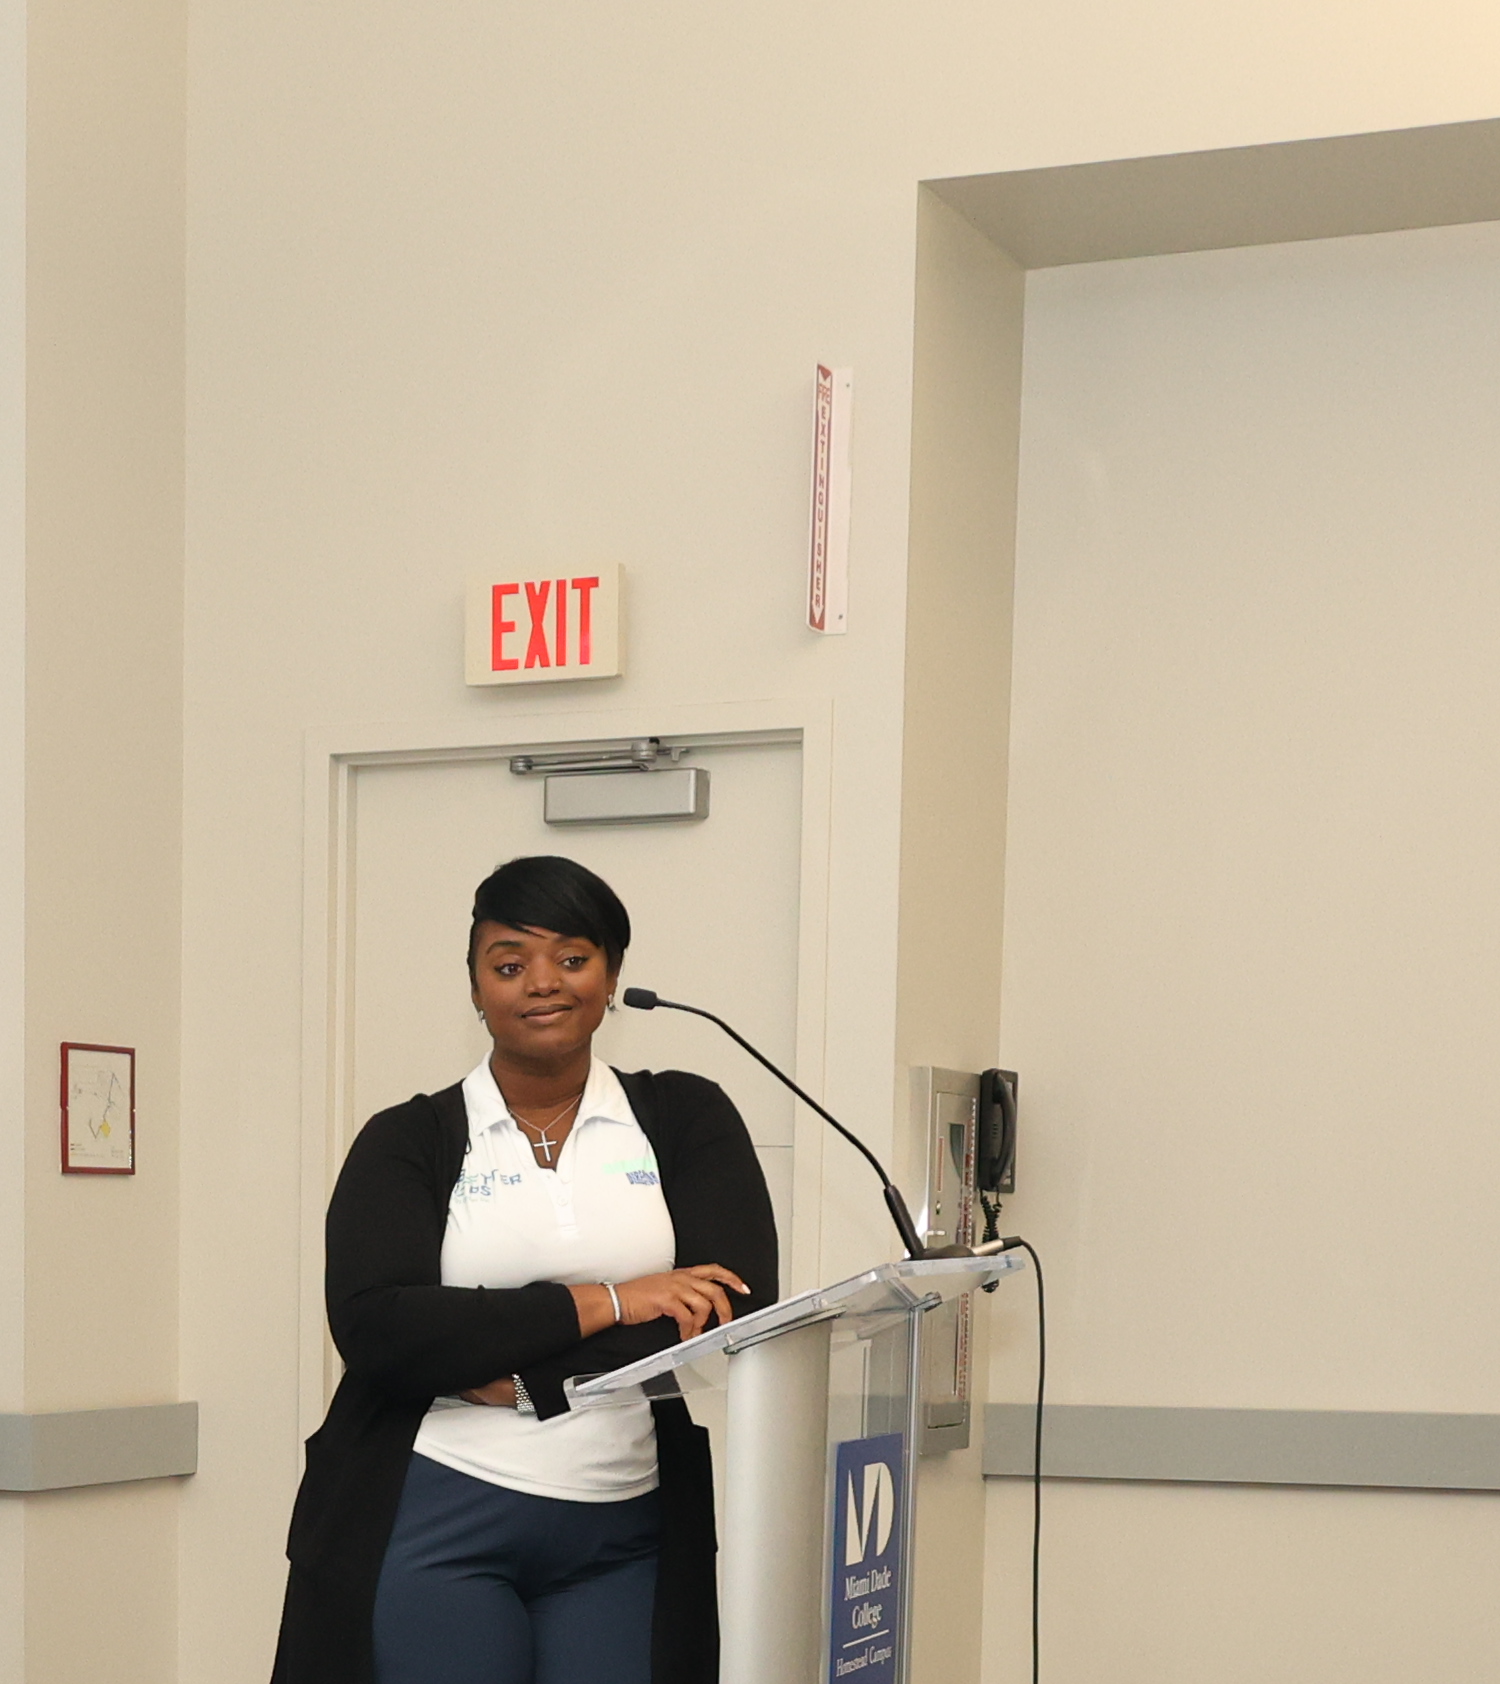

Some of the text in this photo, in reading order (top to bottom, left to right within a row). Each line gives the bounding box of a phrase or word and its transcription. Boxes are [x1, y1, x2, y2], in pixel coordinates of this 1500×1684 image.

[492, 576, 599, 671] EXIT
[844, 1565, 892, 1601] Miami Dade
[852, 1602, 883, 1630] College
